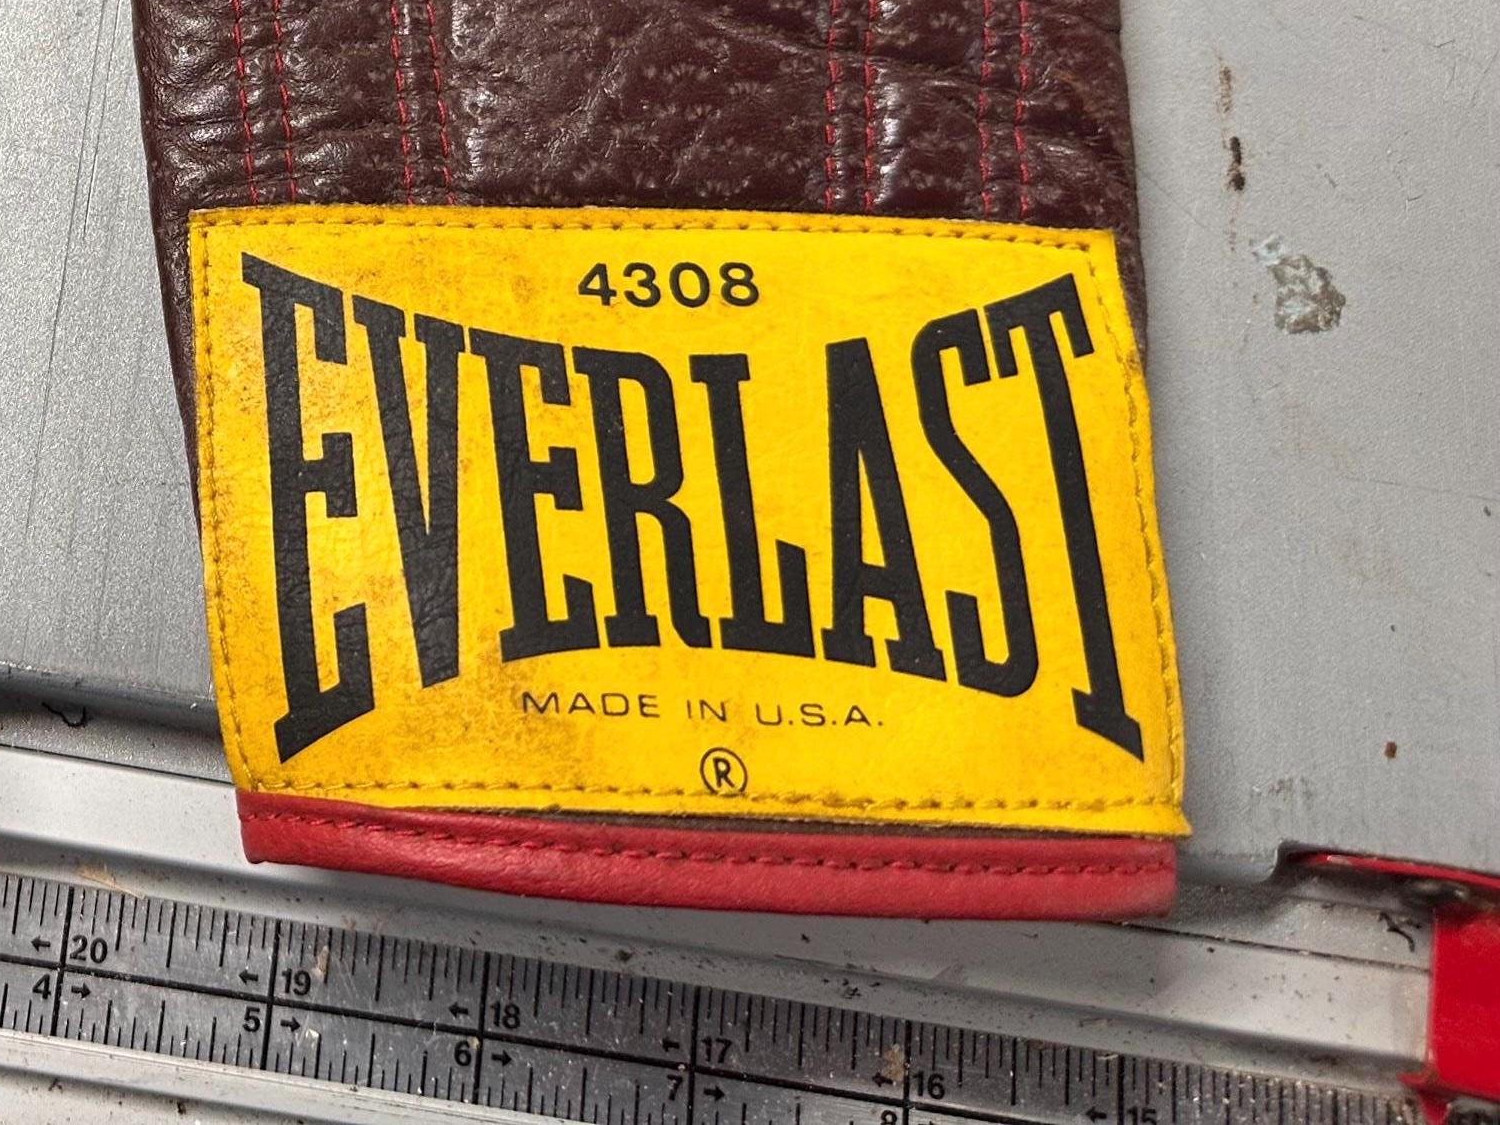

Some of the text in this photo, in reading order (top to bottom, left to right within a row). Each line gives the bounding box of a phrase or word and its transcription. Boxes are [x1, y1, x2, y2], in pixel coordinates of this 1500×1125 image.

[577, 261, 761, 309] 4308
[241, 251, 1145, 763] EVERLAST
[522, 691, 884, 727] MADE IN U.S.A.
[69, 936, 108, 964] 20
[32, 975, 51, 1000] 4
[281, 968, 311, 997] 19
[243, 1007, 261, 1032] 5
[490, 1004, 520, 1030] 18
[454, 1041, 472, 1067] 6
[702, 1038, 732, 1065] 17
[667, 1077, 684, 1102] 7
[912, 1071, 945, 1099] 16
